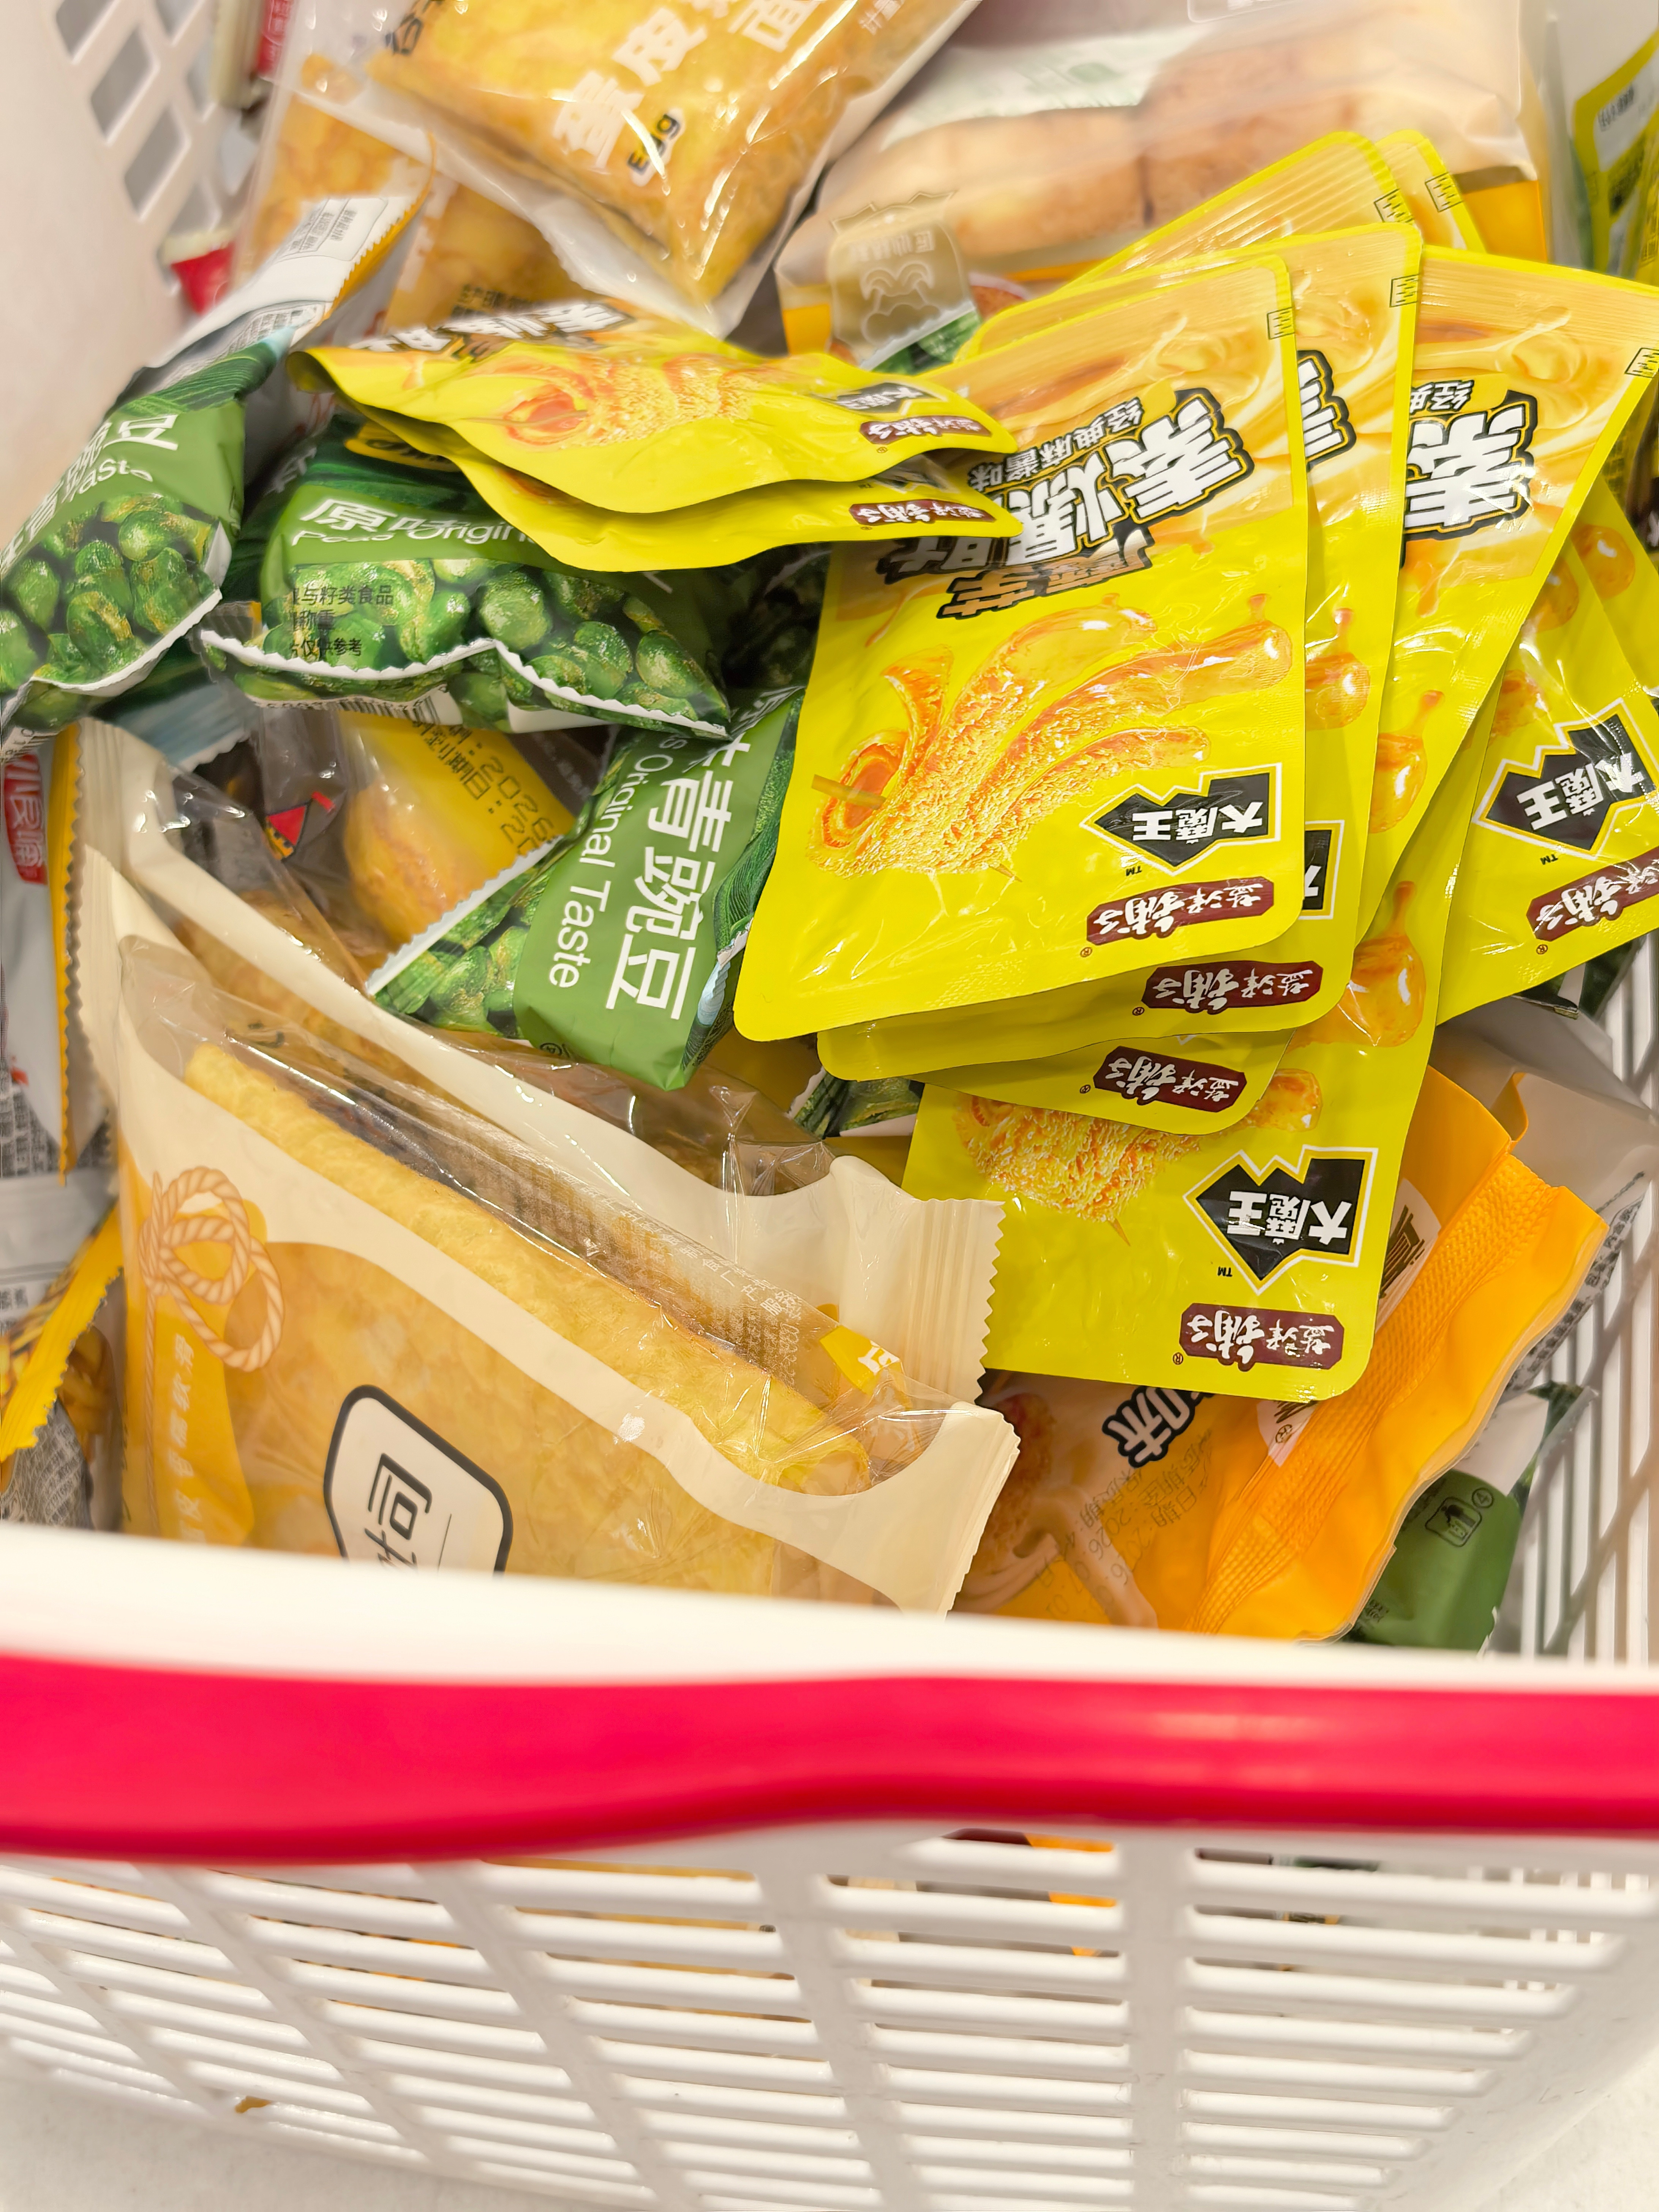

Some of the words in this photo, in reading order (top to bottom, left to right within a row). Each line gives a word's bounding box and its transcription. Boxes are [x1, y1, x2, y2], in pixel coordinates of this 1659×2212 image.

[628, 112, 681, 174] Egg
[867, 418, 983, 439] 盐津铺子
[967, 397, 1145, 493] 经典麻酱味
[858, 500, 985, 523] 盐津铺子
[293, 609, 335, 631] 称重
[581, 753, 675, 868] Original
[1515, 752, 1647, 831] 大魔王
[1132, 801, 1263, 845] 大魔王
[1093, 879, 1264, 936] 盐津铺子
[549, 886, 612, 989] Taste
[1152, 965, 1314, 1014] 盐津铺子
[1105, 1054, 1240, 1104] 盐津铺子
[1226, 1190, 1352, 1246] 大魔王
[1187, 1309, 1335, 1365] 盐津铺子
[1107, 1386, 1202, 1465] 味
